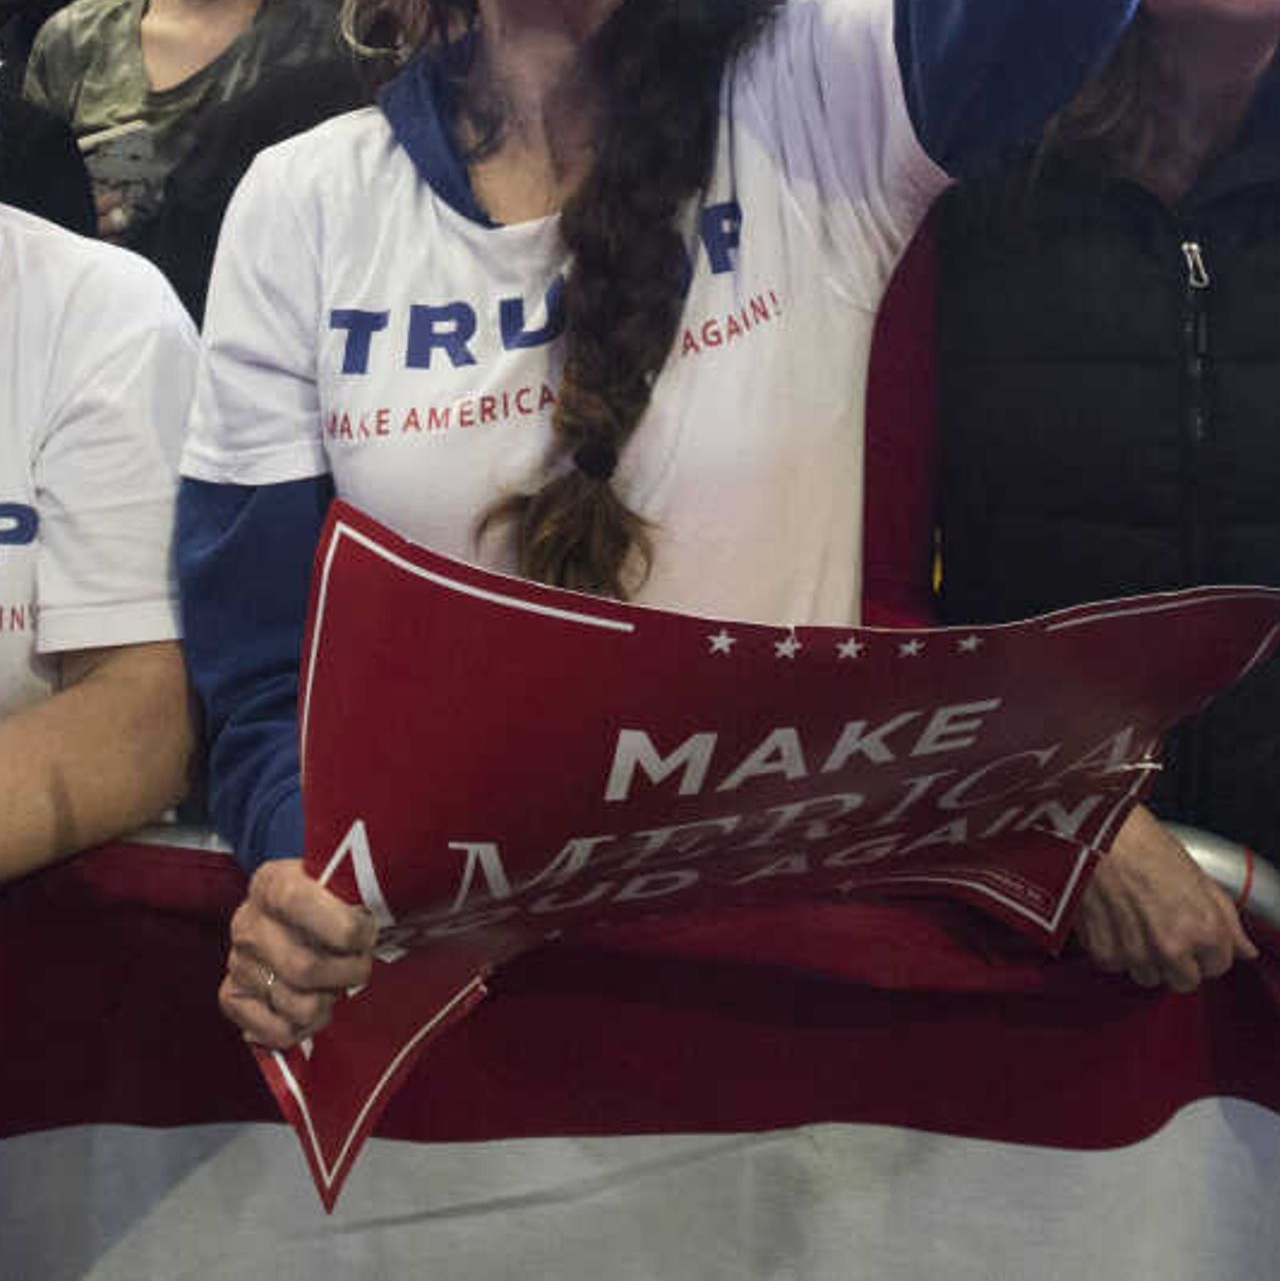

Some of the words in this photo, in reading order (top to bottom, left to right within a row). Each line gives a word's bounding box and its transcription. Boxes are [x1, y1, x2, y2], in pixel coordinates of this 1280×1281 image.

[402, 382, 560, 435] AMERICA
[678, 289, 784, 358] AGAIN!
[604, 697, 1003, 802] MAKE
